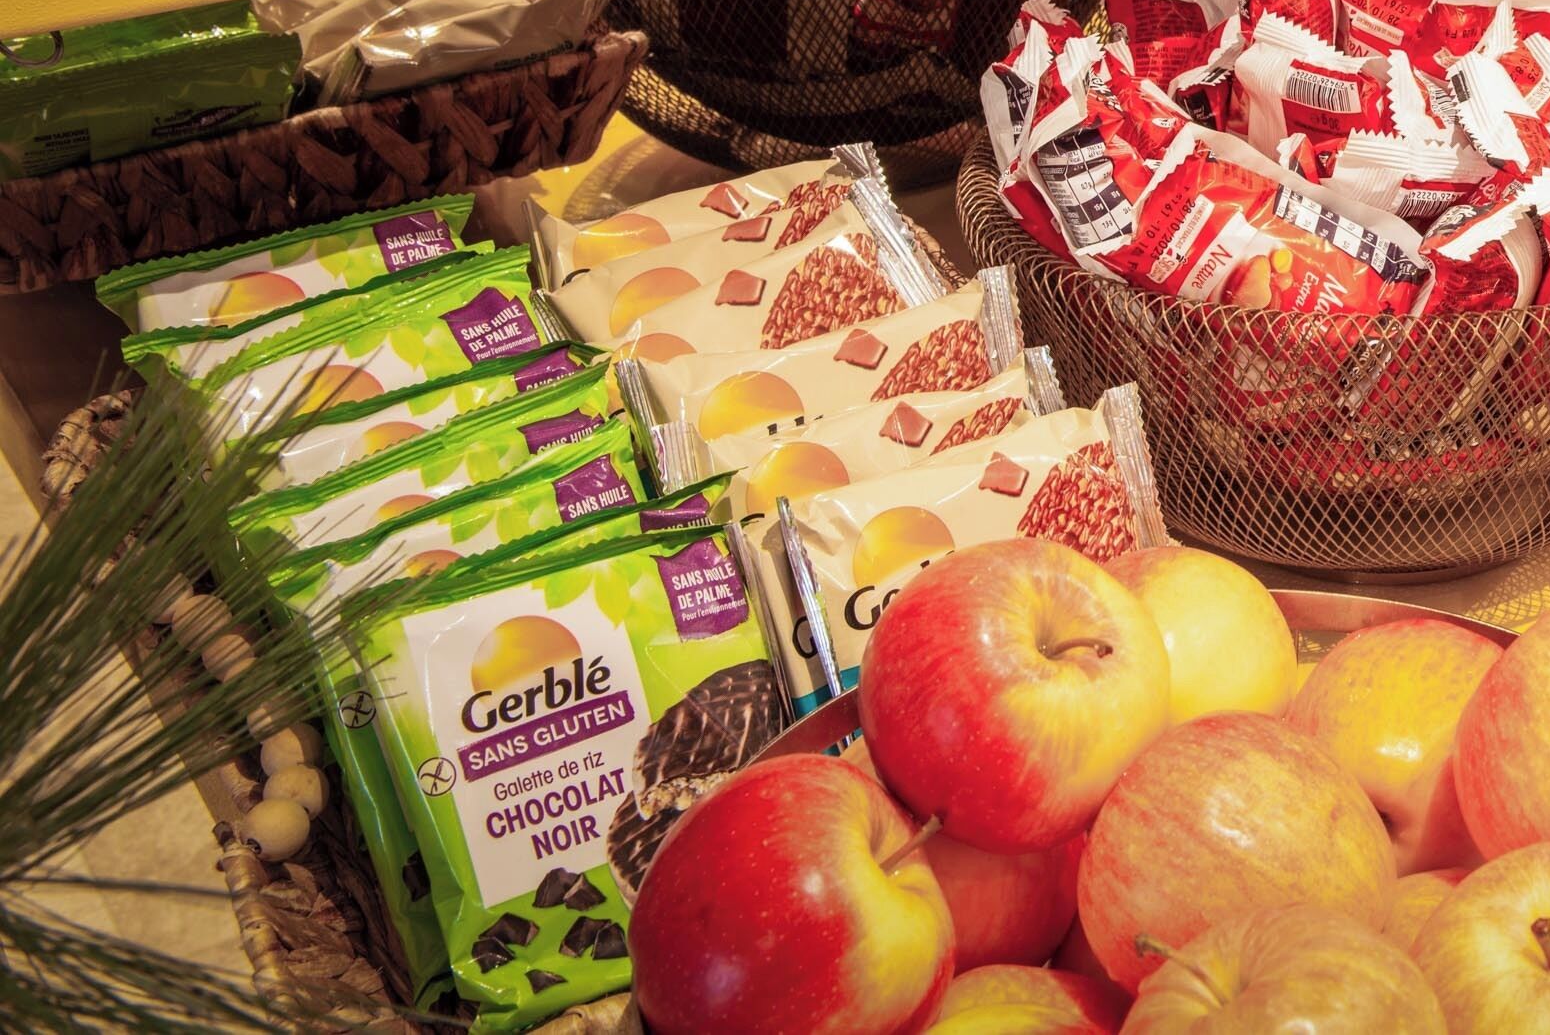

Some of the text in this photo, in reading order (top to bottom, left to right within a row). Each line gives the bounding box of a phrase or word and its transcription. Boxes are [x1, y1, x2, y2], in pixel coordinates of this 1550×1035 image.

[385, 228, 446, 251] SANS HUILE
[390, 244, 444, 266] DE PALME
[1190, 243, 1233, 290] Nature
[460, 304, 524, 342] SANS HUILE
[467, 322, 523, 354] DE PALME
[475, 349, 493, 362] Pour
[567, 484, 630, 520] SANS HUILE
[671, 561, 737, 591] SANS HUILE
[677, 582, 734, 610] DE PALME
[681, 610, 698, 622] Pour
[461, 655, 611, 734] Gerblé
[468, 699, 627, 771] SANS GLUTEN
[493, 749, 606, 802] Galette de riz
[485, 768, 627, 839] CHOCOLAT
[530, 814, 601, 861] NOIR
